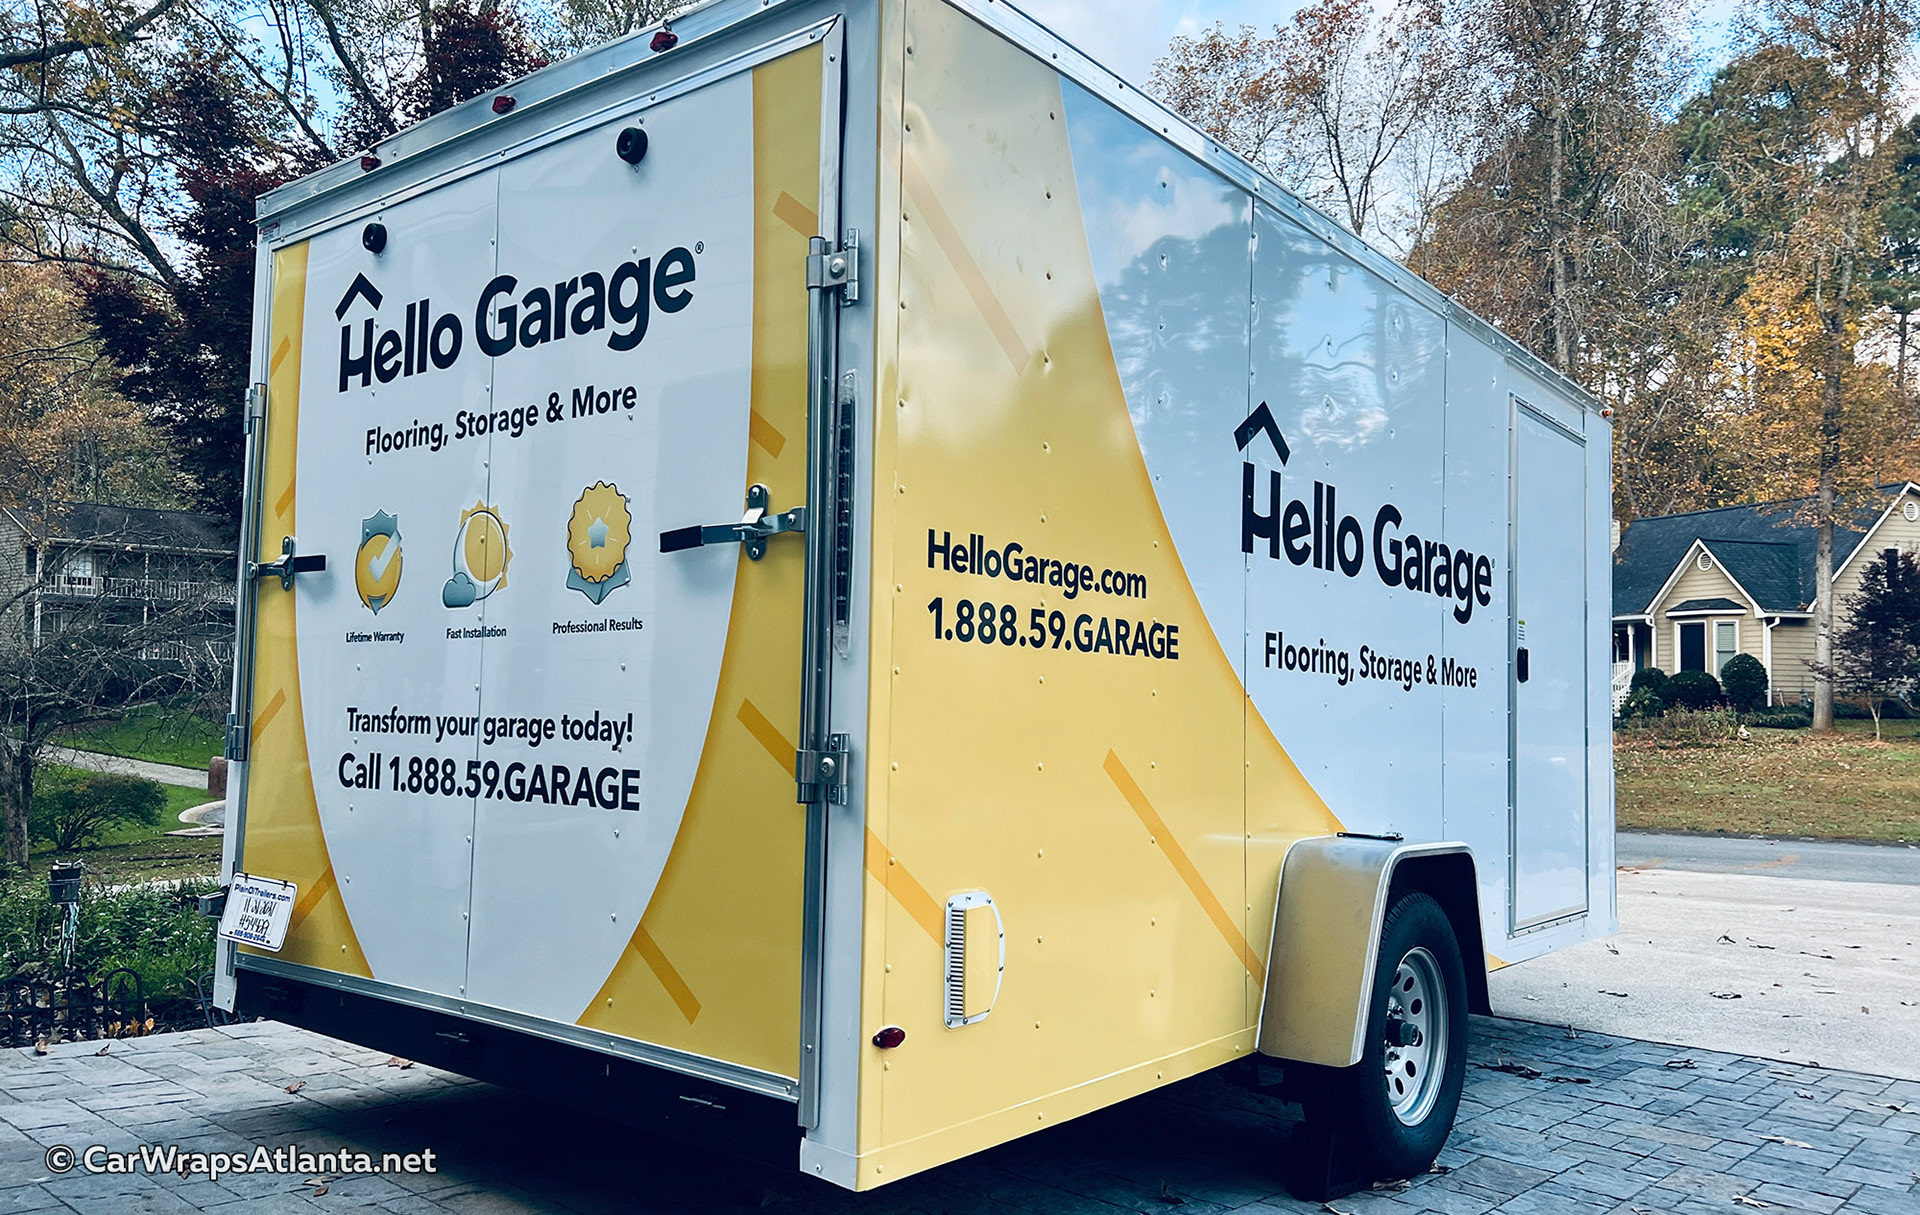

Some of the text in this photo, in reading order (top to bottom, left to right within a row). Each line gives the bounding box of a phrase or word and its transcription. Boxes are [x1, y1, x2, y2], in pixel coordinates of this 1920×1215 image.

[339, 298, 463, 393] Hello
[365, 382, 637, 456] Flooring, Storage & More
[1242, 461, 1364, 578] Hello
[927, 529, 1147, 600] HelloGarage.com
[346, 631, 404, 644] Lifetime Warranty
[446, 625, 507, 639] Fast Installation
[552, 617, 643, 634] Professional Results
[927, 597, 1179, 660] 1.888.59.GARAGE
[1265, 632, 1477, 691] Flooring, Storage & More
[347, 707, 633, 750] Transform your garage today!
[339, 752, 641, 811] Call 1.888.59.GARAGE
